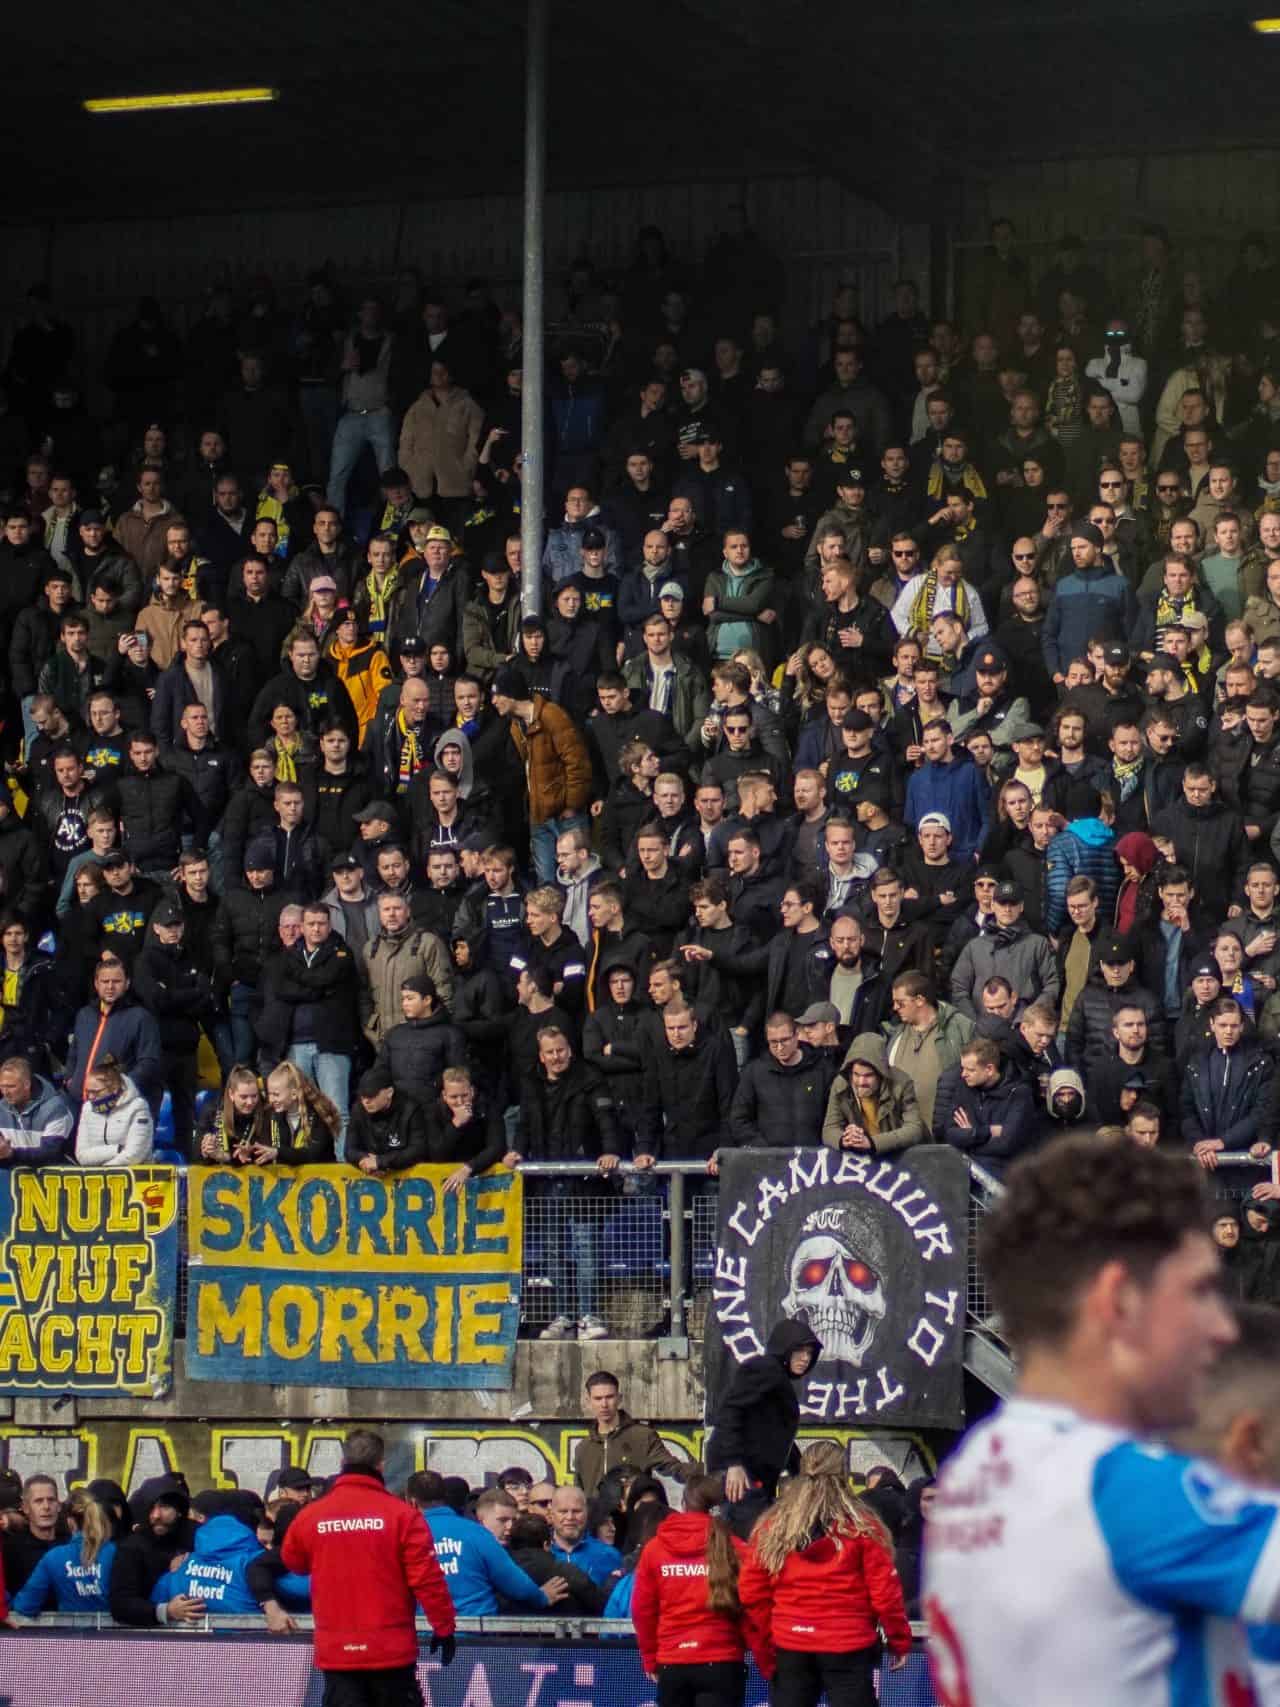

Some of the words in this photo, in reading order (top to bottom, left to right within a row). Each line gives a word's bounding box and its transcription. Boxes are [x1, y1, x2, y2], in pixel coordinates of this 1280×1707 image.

[18, 1174, 141, 1234] NUL
[200, 1171, 516, 1256] SKORRIE
[10, 1244, 149, 1304] VIJF
[727, 1147, 954, 1261] CAMBUUR
[907, 1290, 958, 1367] TO
[0, 1313, 159, 1374] ACHT
[197, 1281, 513, 1364] MORRIE
[317, 1518, 384, 1534] STEWARD
[433, 1536, 462, 1557] rity
[185, 1560, 233, 1584] Security
[189, 1579, 226, 1600] Noord
